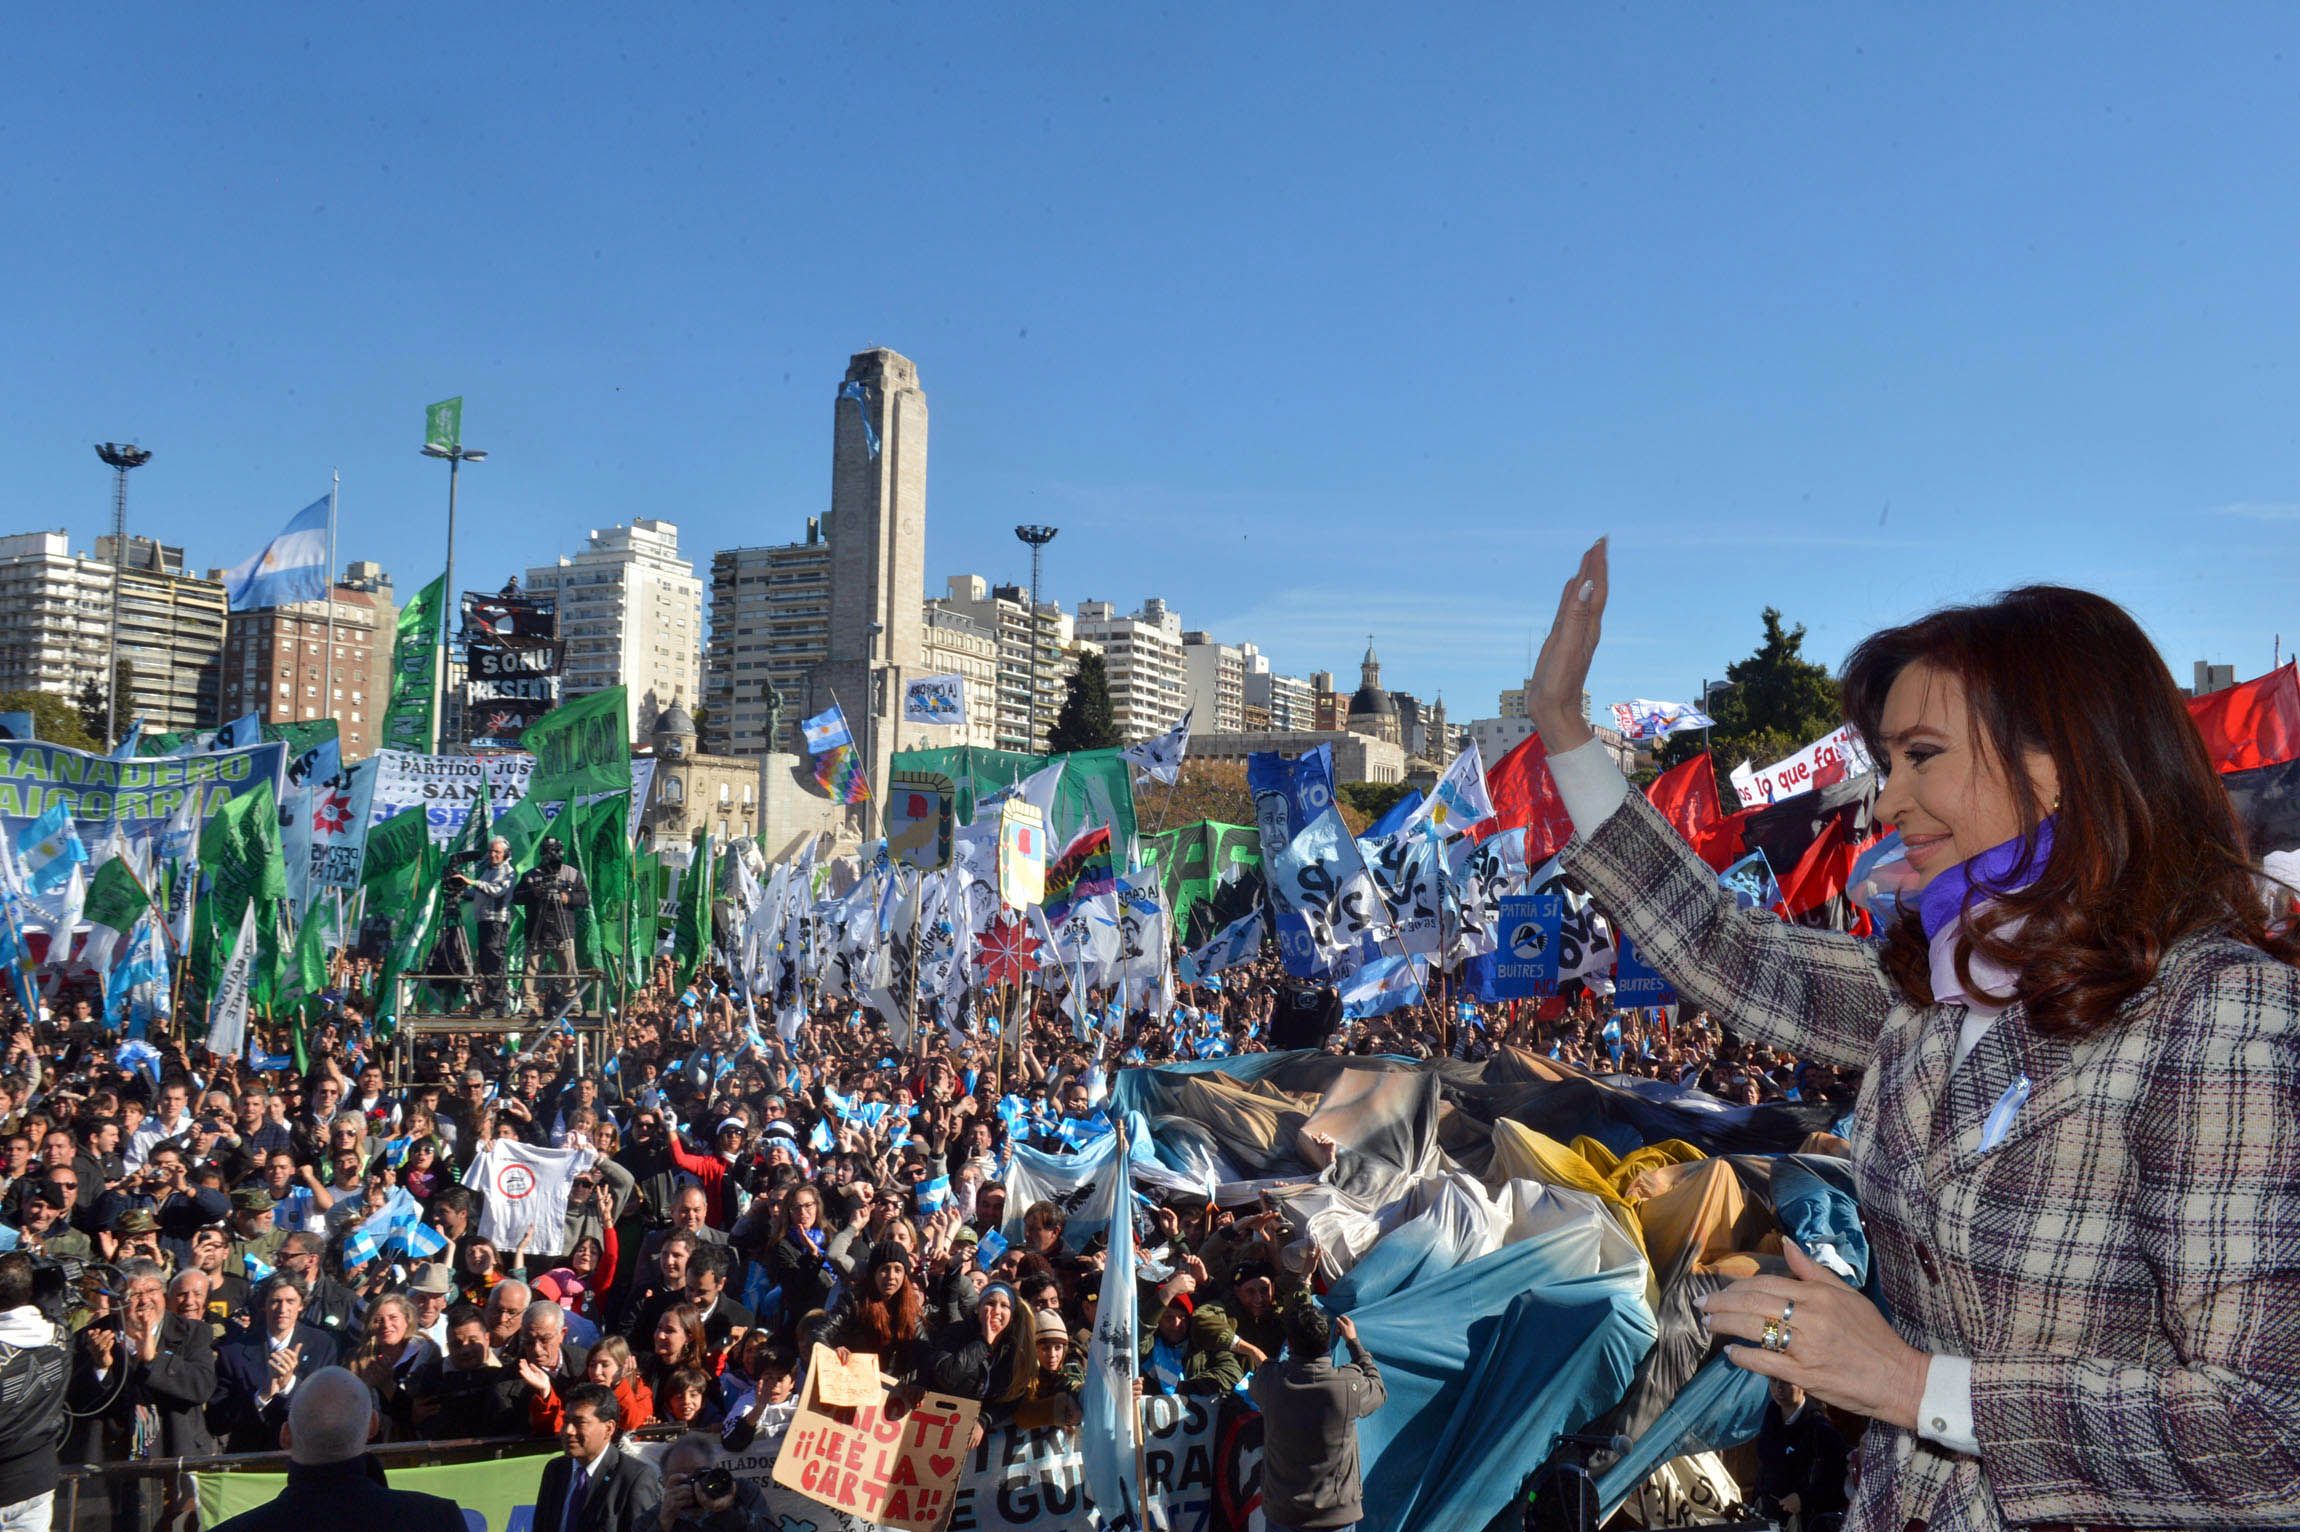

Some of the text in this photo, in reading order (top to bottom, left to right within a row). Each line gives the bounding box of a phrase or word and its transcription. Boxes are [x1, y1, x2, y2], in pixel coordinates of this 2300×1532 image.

[400, 760, 481, 776] PARTIDO
[1754, 777, 1773, 797] lo
[1778, 762, 1810, 793] que
[873, 1450, 919, 1486] LA
